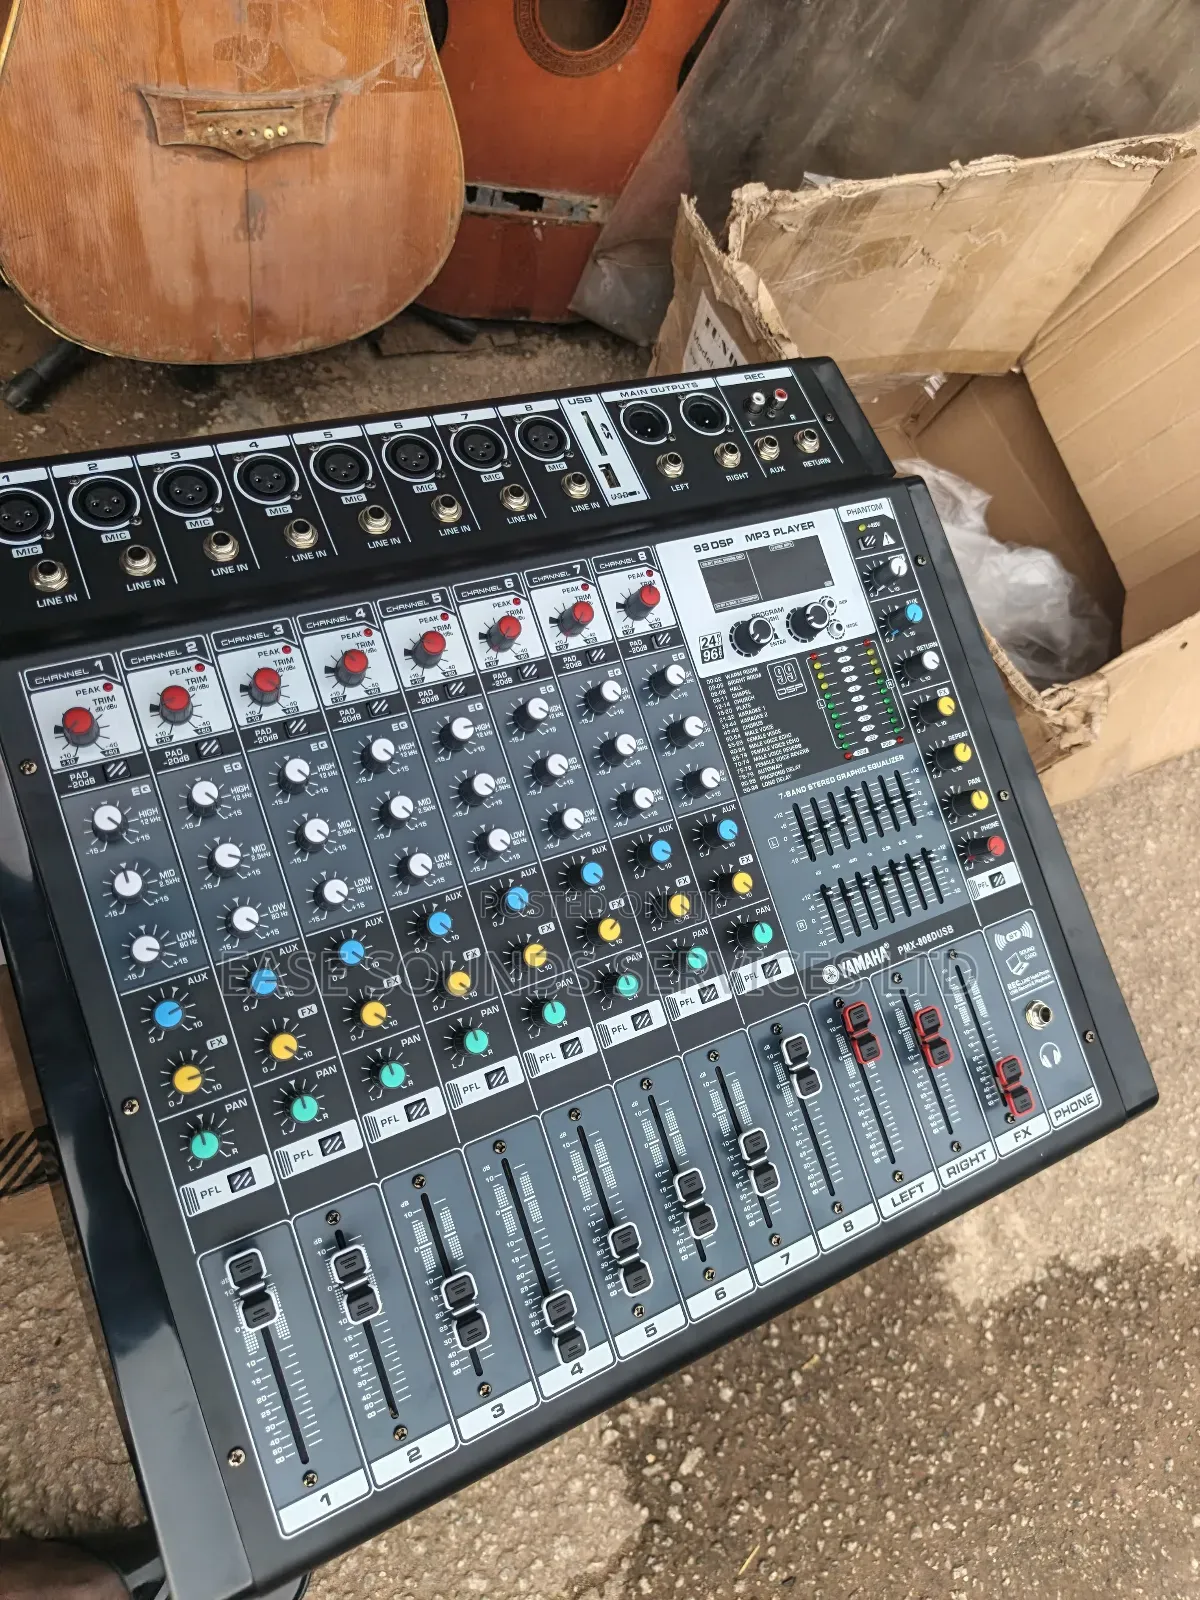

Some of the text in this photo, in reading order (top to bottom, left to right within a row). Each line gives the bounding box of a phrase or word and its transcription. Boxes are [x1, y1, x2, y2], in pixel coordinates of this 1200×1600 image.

[744, 372, 765, 381] REC
[620, 381, 698, 399] MAIN OUTPUTS
[568, 396, 592, 405] USB
[171, 452, 181, 460] 3
[87, 463, 99, 471] 2
[803, 457, 831, 468] RETURN
[770, 466, 786, 475] AUX
[726, 472, 749, 483] RIGHT
[671, 482, 690, 492] LEFT
[269, 506, 289, 515] MIC
[846, 504, 883, 516] PHANTOM
[189, 519, 210, 528] MIC
[507, 513, 537, 525] LINE IN
[438, 524, 471, 537] LINE IN
[745, 531, 770, 543] MP3
[773, 521, 815, 536] PLAYER
[104, 532, 128, 541] MIC
[367, 536, 401, 550] LINE IN
[15, 547, 39, 556] MIC
[292, 550, 327, 563] LINE IN
[599, 551, 647, 570] CHANNEL 8
[211, 563, 249, 577] LINE IN
[532, 564, 581, 584] CHANNEL 7
[628, 571, 645, 580] PEAK
[126, 578, 166, 592] LINE IN
[460, 578, 514, 598] CHANNEL 6
[561, 584, 581, 594] PEAK
[36, 593, 78, 608] LINE IN
[385, 593, 441, 613] CHANNEL 5
[492, 599, 512, 609] PEAK
[305, 607, 366, 629] CHANNEL 4
[419, 614, 438, 624] PEAK
[432, 623, 453, 633] TRIM
[220, 624, 285, 647] CHANNEL 3
[340, 630, 362, 640] PEAK
[355, 640, 376, 650] TRIM
[629, 640, 643, 649] PAD
[701, 636, 716, 648] 24
[916, 641, 938, 652] RETURN
[130, 641, 199, 665] CHANNEL 2
[257, 648, 280, 658] PEAK
[703, 648, 718, 662] 96
[272, 657, 295, 667] TRIM
[34, 660, 104, 685] CHANNEL 1
[169, 666, 193, 676] PEAK
[492, 672, 508, 681] PAD
[185, 675, 208, 686] TRIM
[75, 686, 101, 697] PEAK
[539, 685, 555, 694] EQ
[92, 695, 117, 706] TRIM
[468, 702, 484, 712] EQ
[736, 703, 752, 711] PLATE
[391, 721, 408, 731] EQ
[255, 727, 272, 738] PAD
[948, 731, 968, 741] REPEAT
[310, 741, 328, 752] EQ
[398, 742, 416, 753] HIGH
[164, 748, 184, 759] PAD
[223, 762, 243, 773] EQ
[316, 763, 336, 773] HIGH
[69, 771, 90, 782] PAD
[778, 754, 904, 800] 7-BAND STEREO GRAPHIC EQUALIZER
[131, 784, 152, 796] EQ
[230, 784, 250, 795] HIGH
[417, 797, 432, 808] MID
[138, 807, 159, 818] HIGH
[721, 804, 737, 813] AUX
[336, 820, 352, 830] MID
[658, 824, 673, 833] AUX
[981, 821, 999, 832] PHONE
[510, 829, 525, 840] LOW
[251, 843, 268, 854] MID
[591, 845, 608, 855] AUX
[433, 851, 450, 863] LOW
[159, 868, 176, 879] MID
[520, 868, 538, 878] AUX
[354, 877, 372, 887] LOW
[445, 892, 463, 903] AUX
[267, 902, 286, 913] LOW
[755, 905, 771, 915] PAN
[365, 917, 384, 928] AUX
[541, 924, 553, 933] FX
[692, 928, 709, 938] PAN
[176, 929, 195, 942] LOW
[278, 944, 299, 956] AUX
[465, 950, 478, 959] FX
[625, 952, 643, 963] PAN
[187, 972, 209, 985] AUX
[744, 972, 760, 983] PFL
[555, 977, 574, 990] PAN
[679, 997, 695, 1008] PFL
[301, 1006, 315, 1016] FX
[480, 1004, 500, 1017] PAN
[611, 1024, 628, 1036] PFL
[209, 1038, 224, 1047] FX
[400, 1034, 421, 1047] PAN
[539, 1053, 557, 1064] PFL
[315, 1065, 338, 1079] PAN
[462, 1082, 481, 1095] PFL
[224, 1098, 248, 1113] PAN
[1053, 1093, 1094, 1121] PHONE
[380, 1115, 400, 1127] PFL
[1013, 1126, 1032, 1142] FX
[293, 1150, 314, 1162] PFL
[946, 1149, 987, 1178] RIGHT
[200, 1186, 222, 1199] PFL
[891, 1182, 925, 1208] LEFT
[843, 1221, 854, 1232] 8
[781, 1252, 791, 1265] 7
[715, 1287, 727, 1299] 6
[645, 1323, 657, 1337] 5
[571, 1363, 584, 1376] 4
[491, 1402, 506, 1419] 3
[407, 1447, 423, 1463] 2
[320, 1493, 332, 1507] 1
